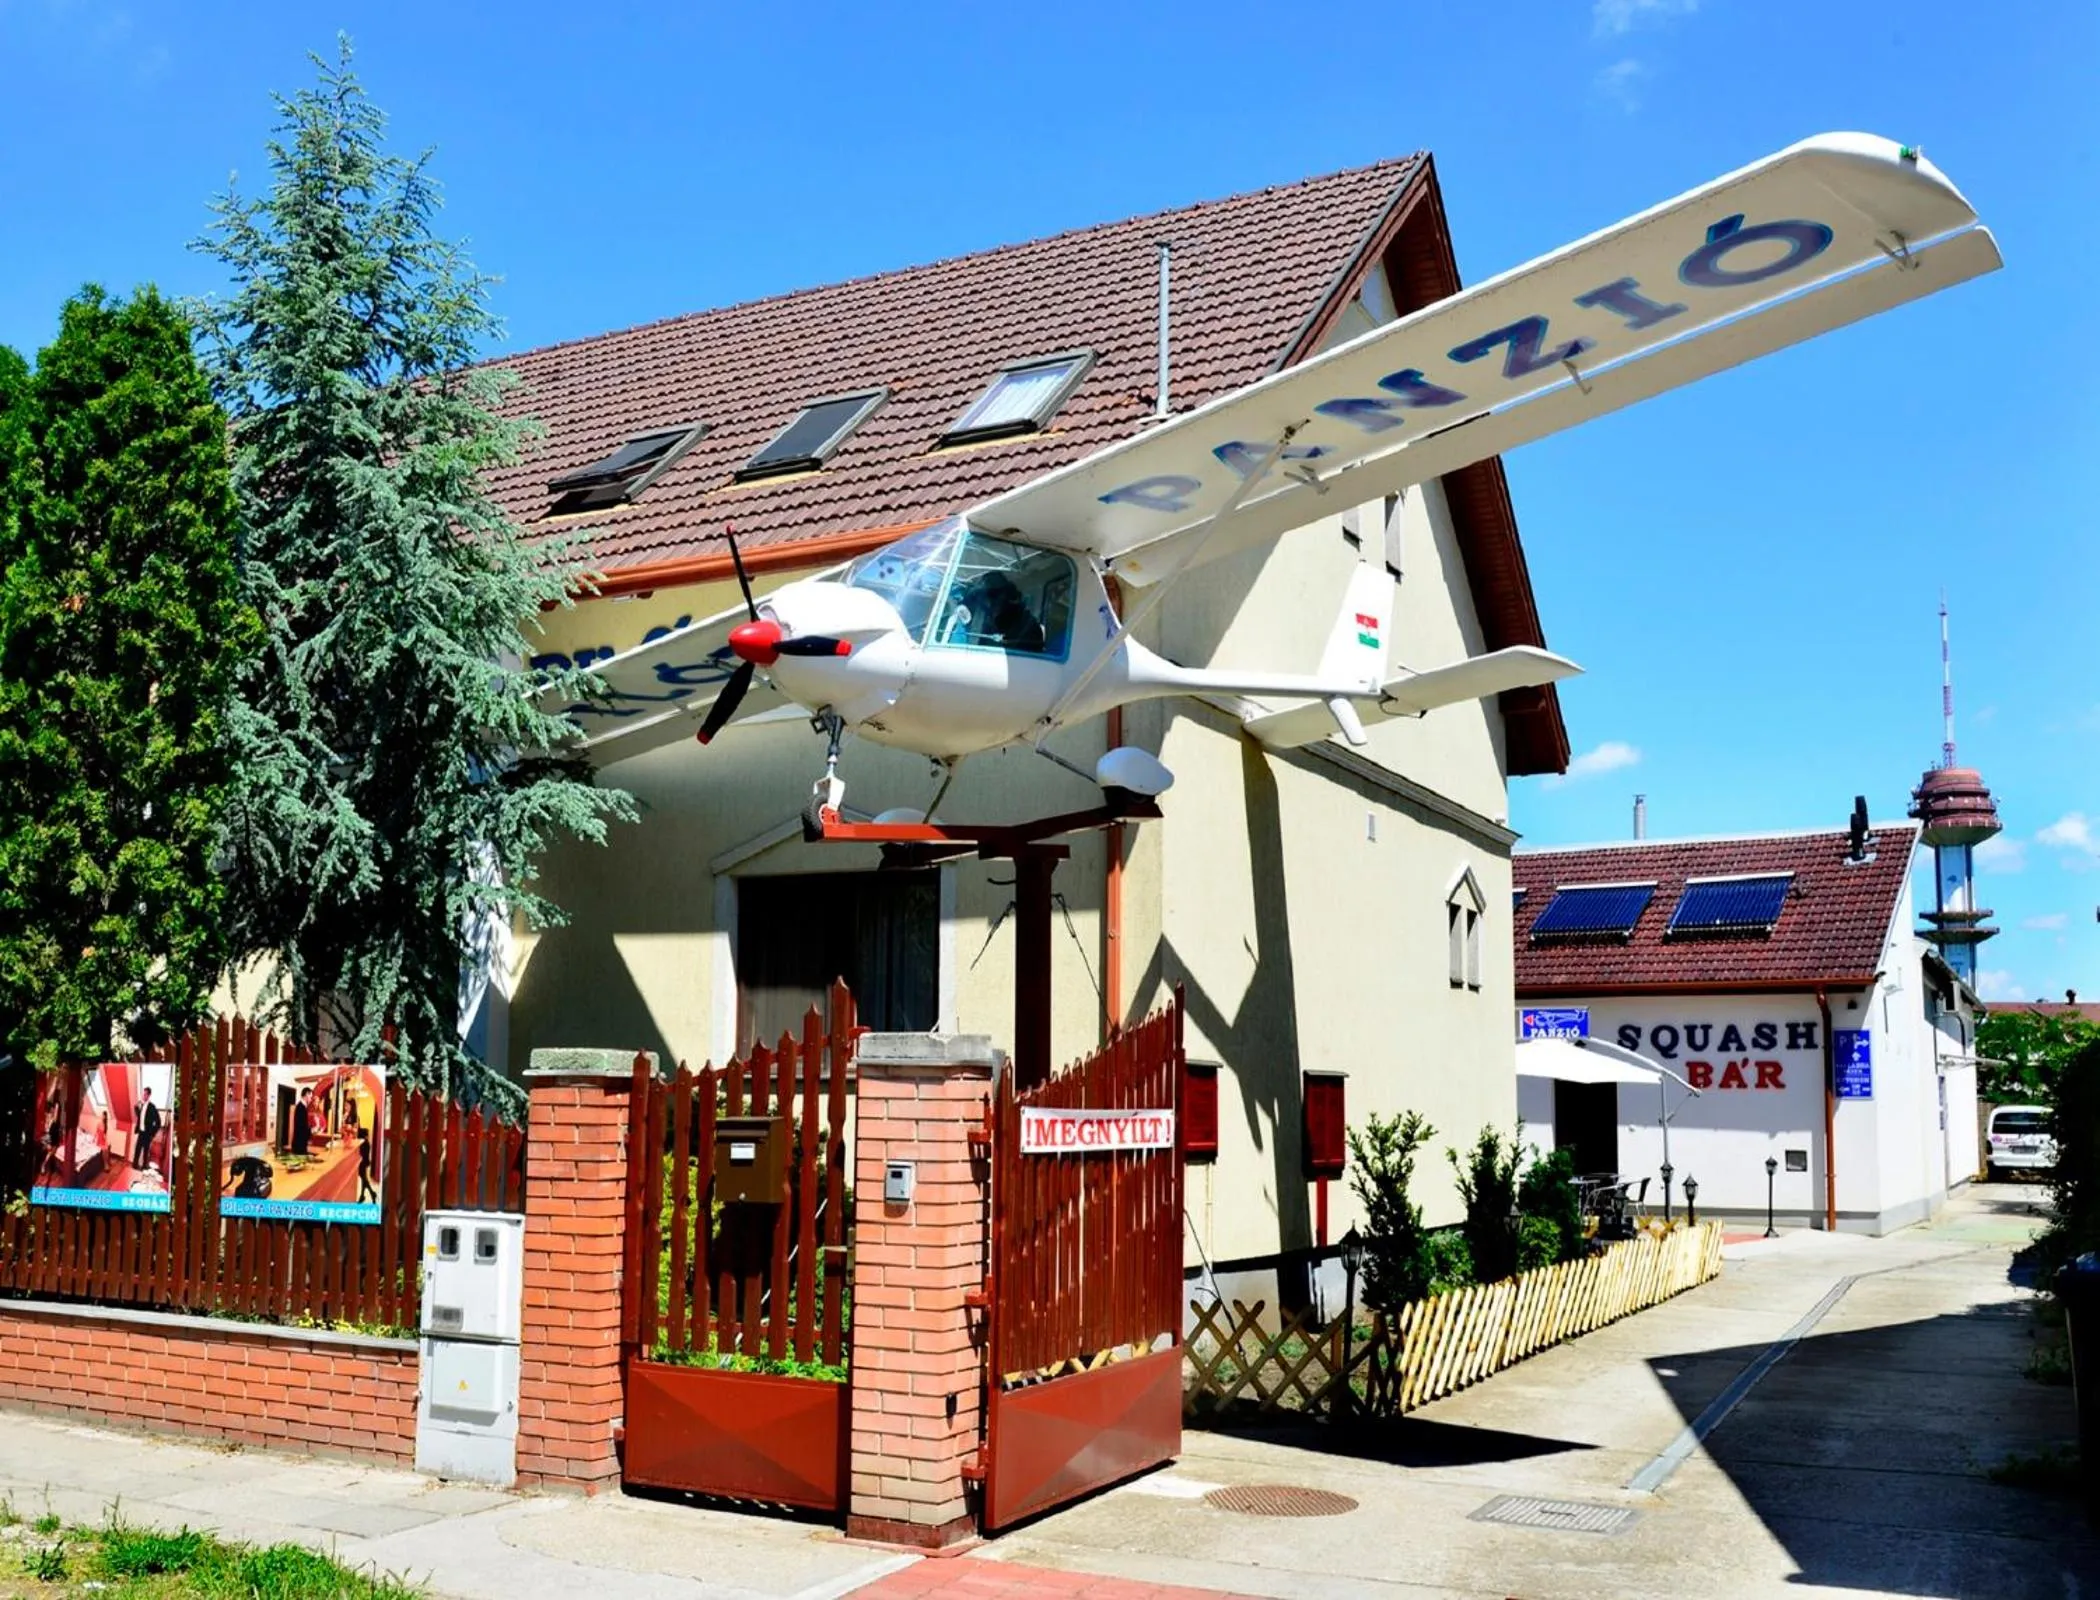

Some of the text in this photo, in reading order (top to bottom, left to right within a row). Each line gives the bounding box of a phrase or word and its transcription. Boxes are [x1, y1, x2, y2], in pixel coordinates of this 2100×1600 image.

[1097, 213, 1834, 513] PANZIÓ
[1617, 1022, 1818, 1059] SQUASH
[1685, 1057, 1786, 1089] BÁR
